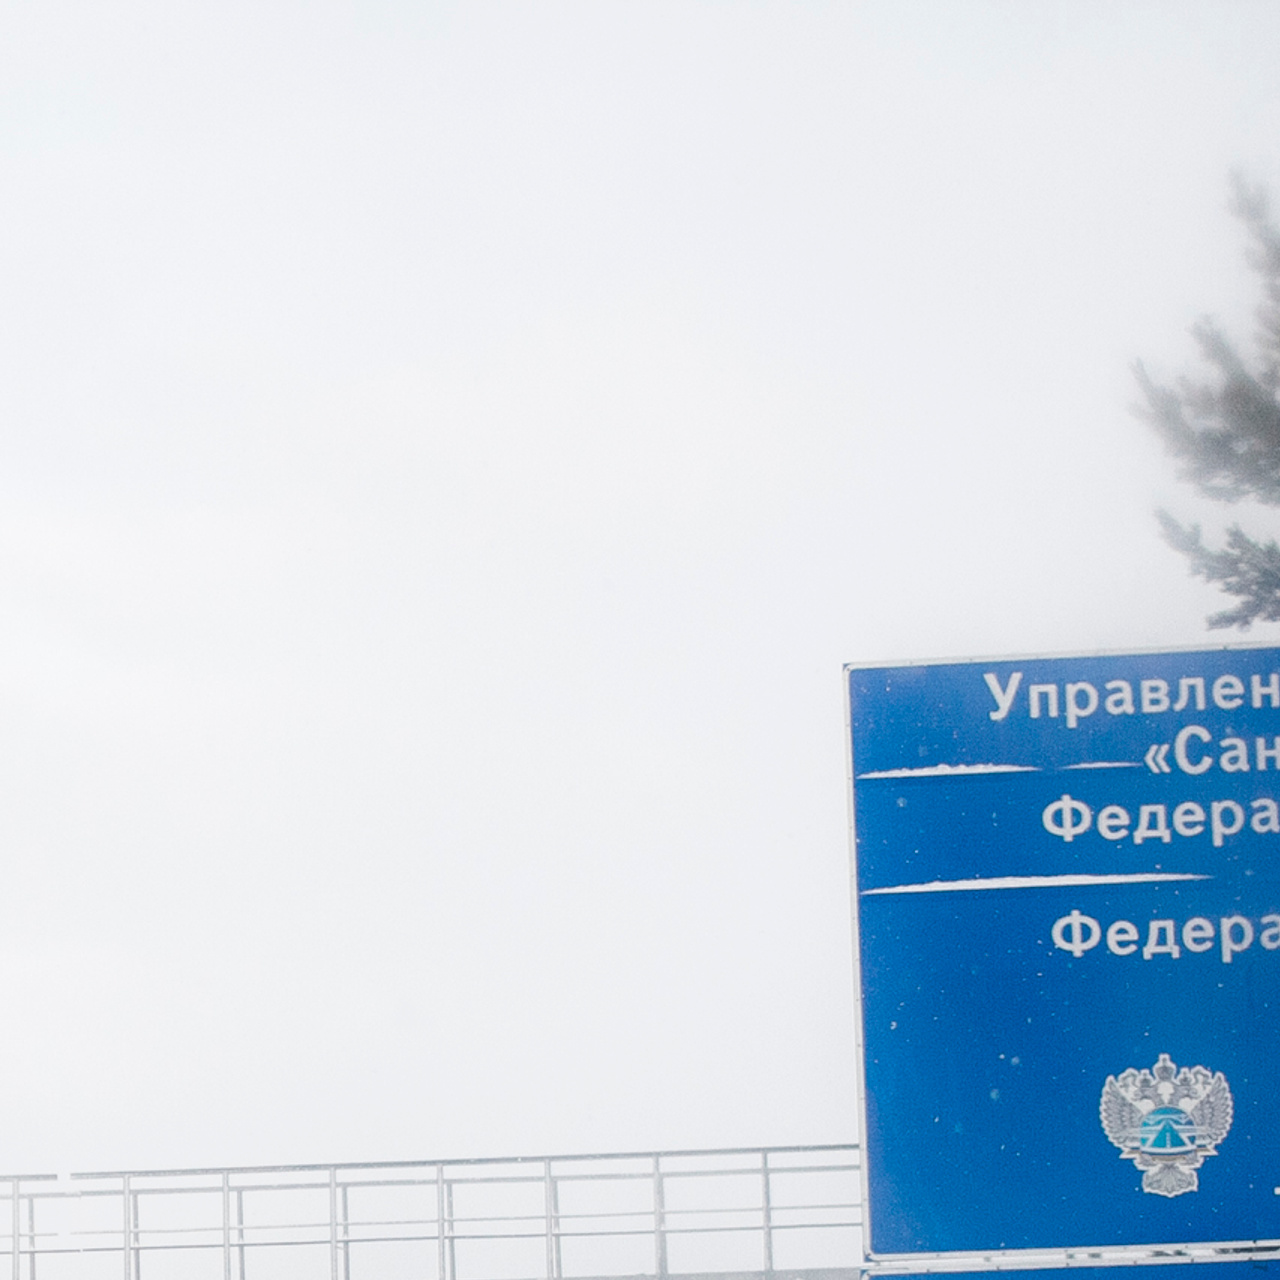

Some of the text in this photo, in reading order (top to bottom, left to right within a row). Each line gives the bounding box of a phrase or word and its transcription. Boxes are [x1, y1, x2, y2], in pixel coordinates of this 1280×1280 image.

[983, 671, 1280, 728] Управлен
[1041, 794, 1280, 847] Федера
[1051, 909, 1280, 963] Федера
